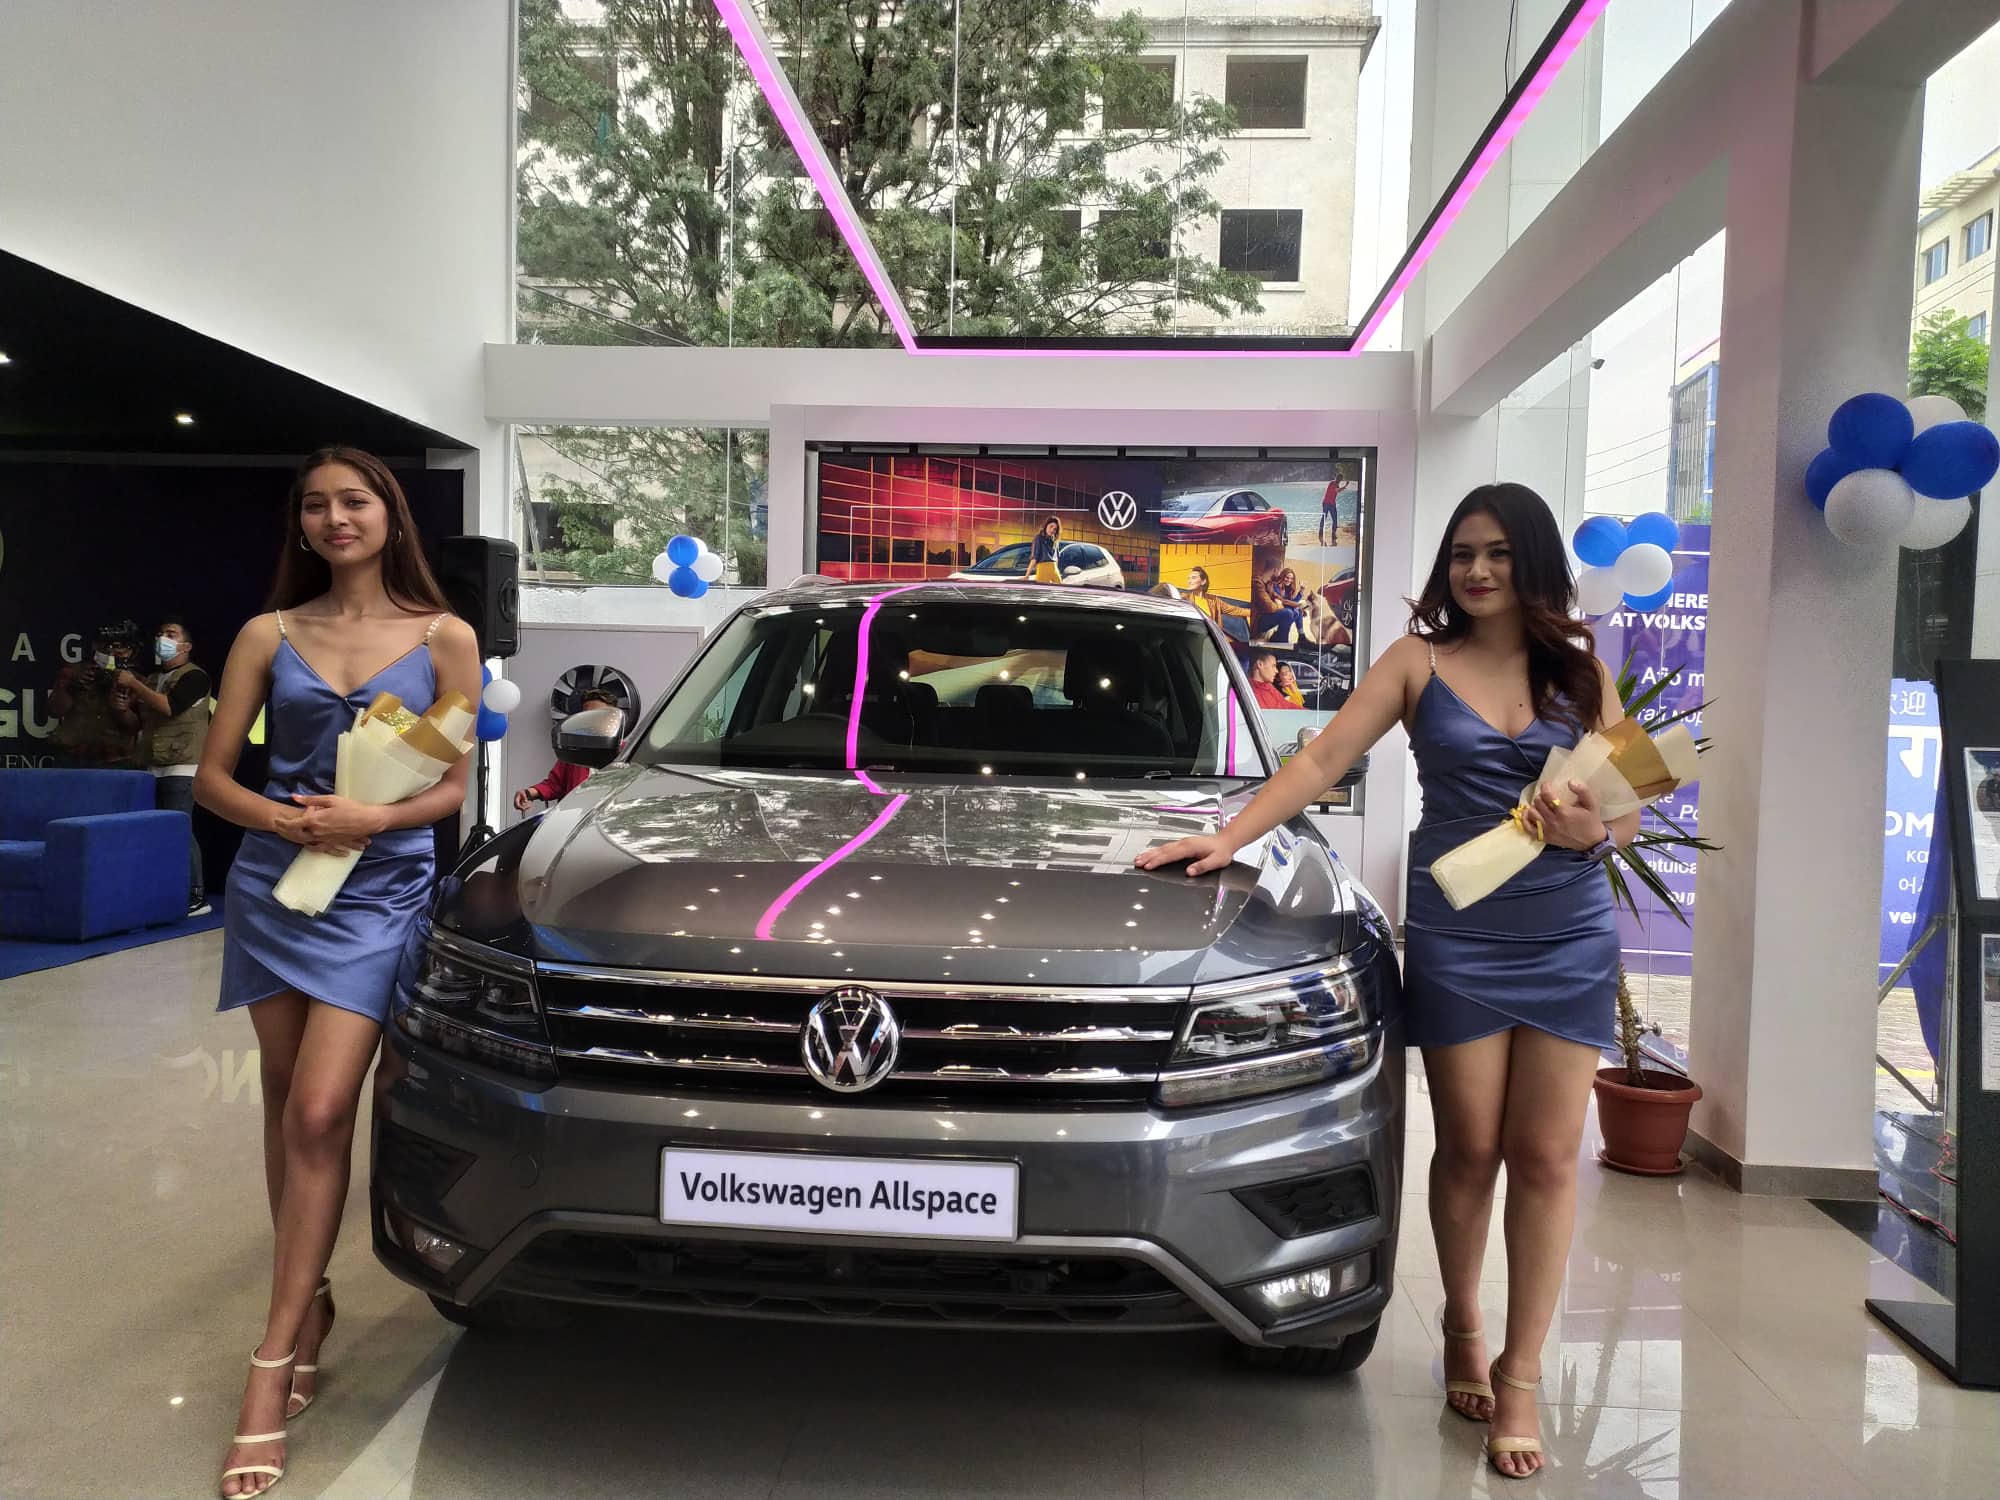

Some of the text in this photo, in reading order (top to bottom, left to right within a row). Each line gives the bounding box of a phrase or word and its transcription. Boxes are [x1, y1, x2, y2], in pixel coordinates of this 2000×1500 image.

[1608, 612, 1708, 631] AT VOLKS
[1898, 877, 1926, 894] 어
[680, 1171, 997, 1220] Volkswagen Allspace
